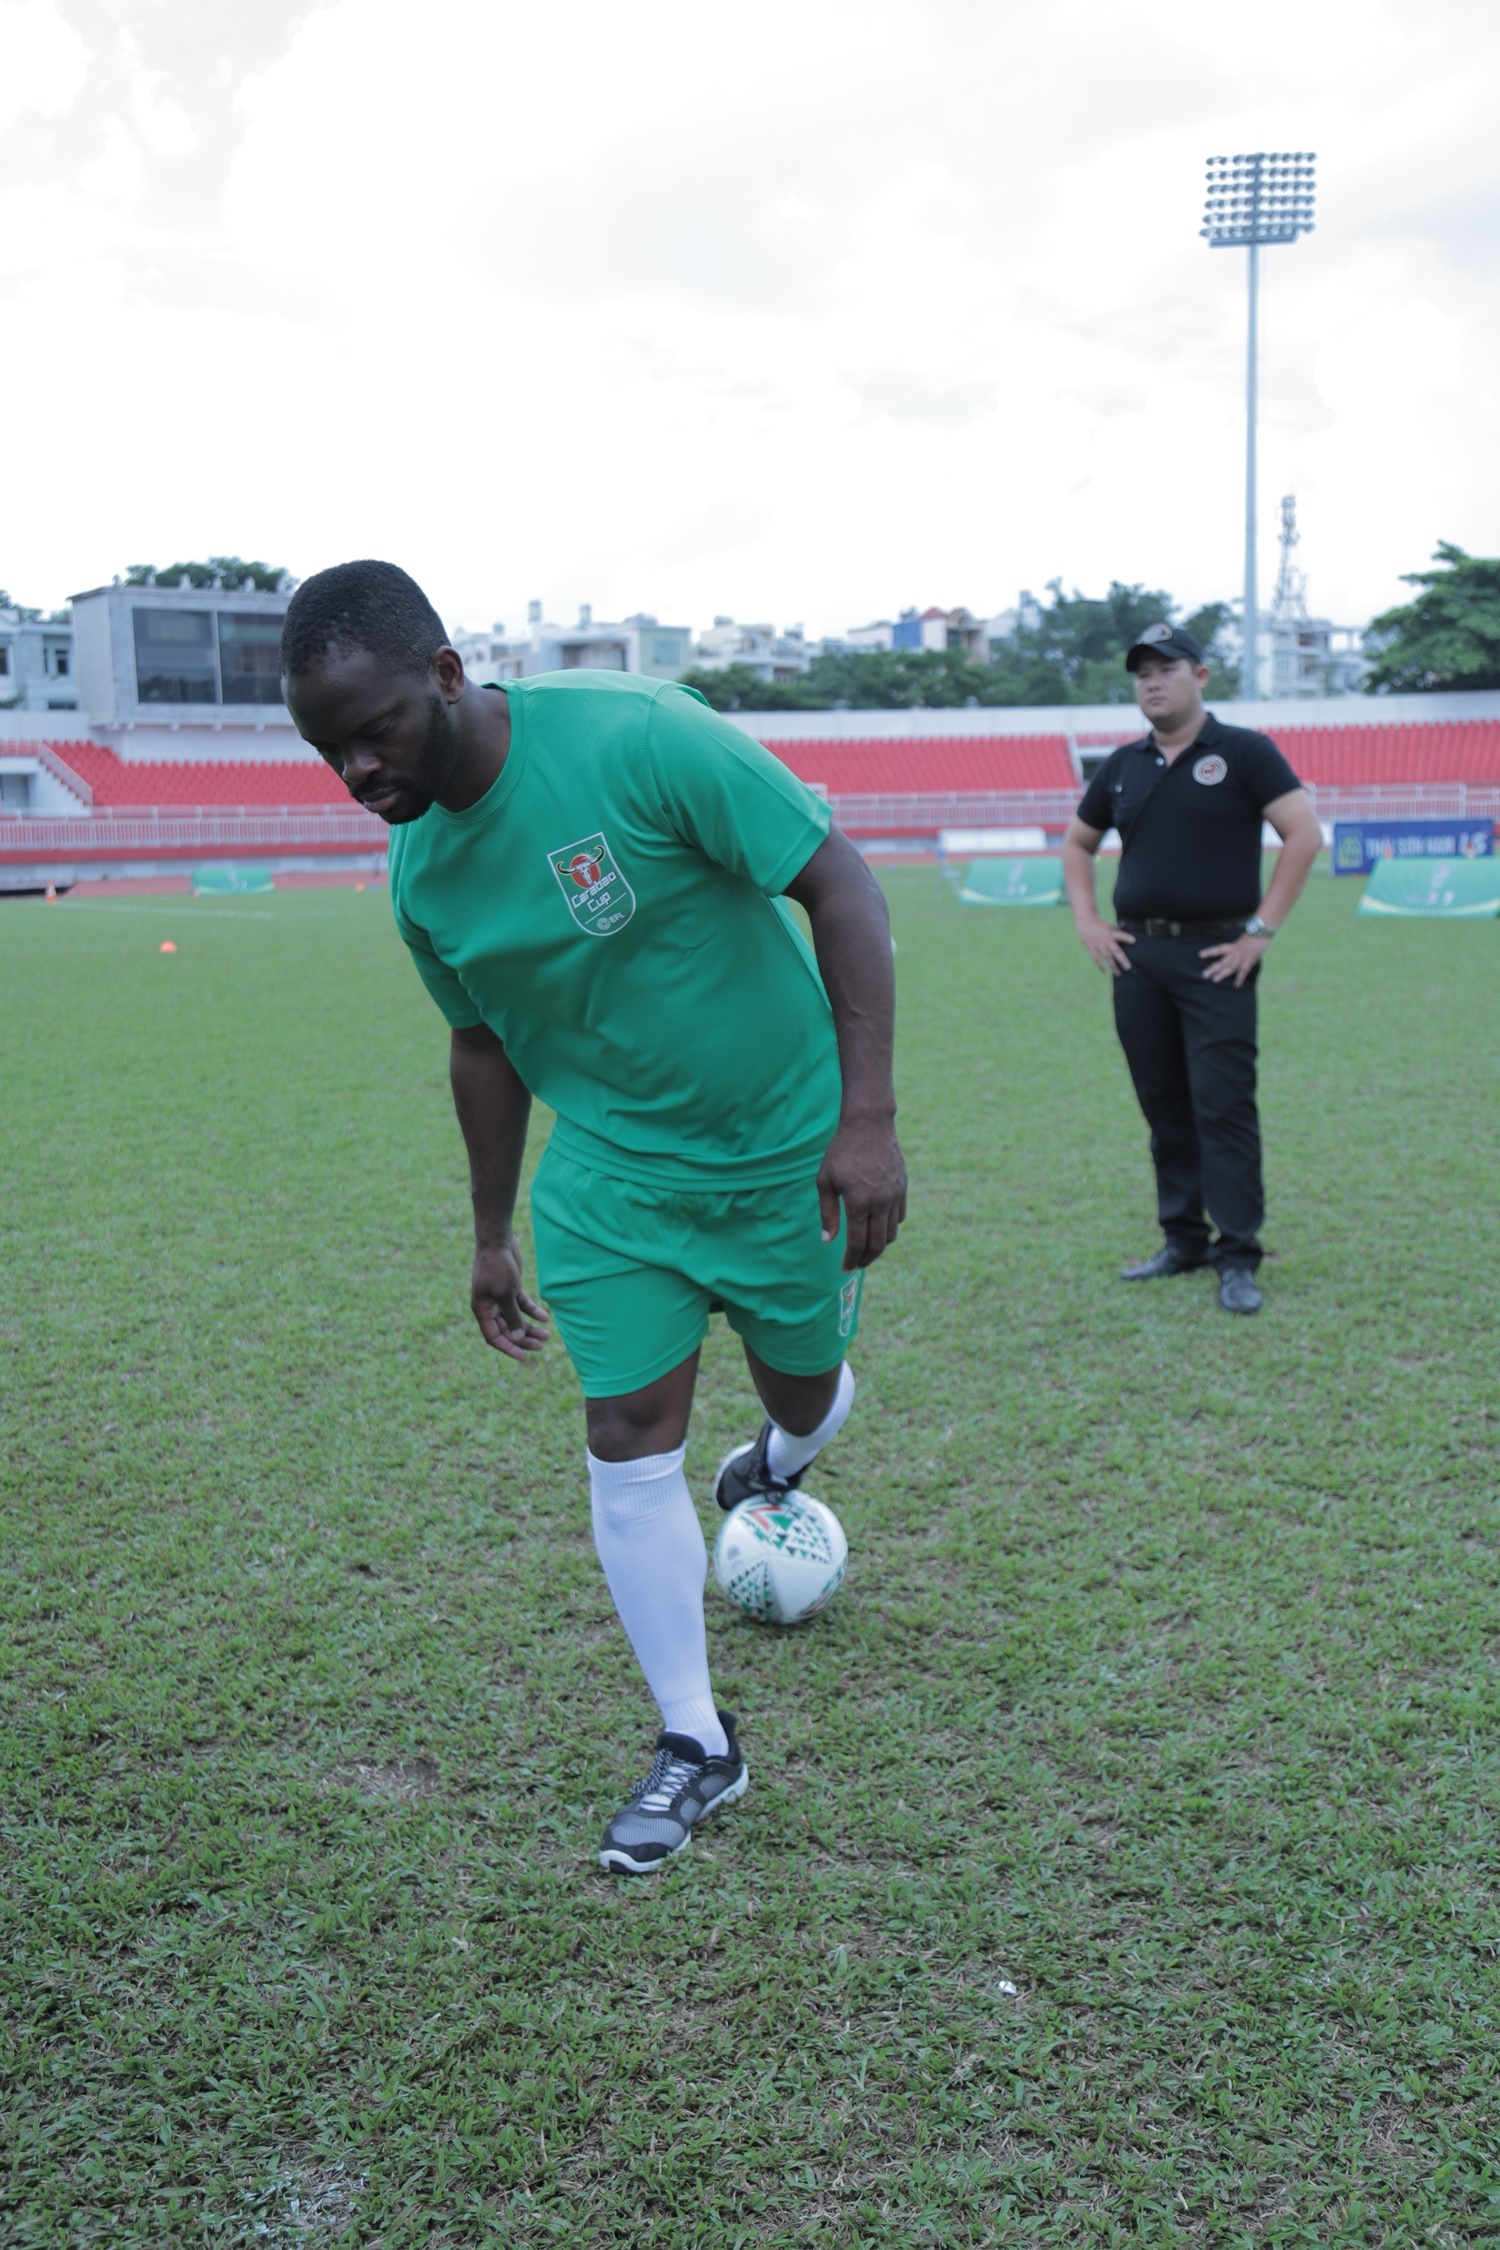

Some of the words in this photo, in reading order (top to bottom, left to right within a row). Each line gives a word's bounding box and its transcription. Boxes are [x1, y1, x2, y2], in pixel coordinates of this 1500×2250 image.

[571, 871, 617, 909] Carabao
[587, 891, 612, 913] Cup
[609, 912, 626, 924] EFL
